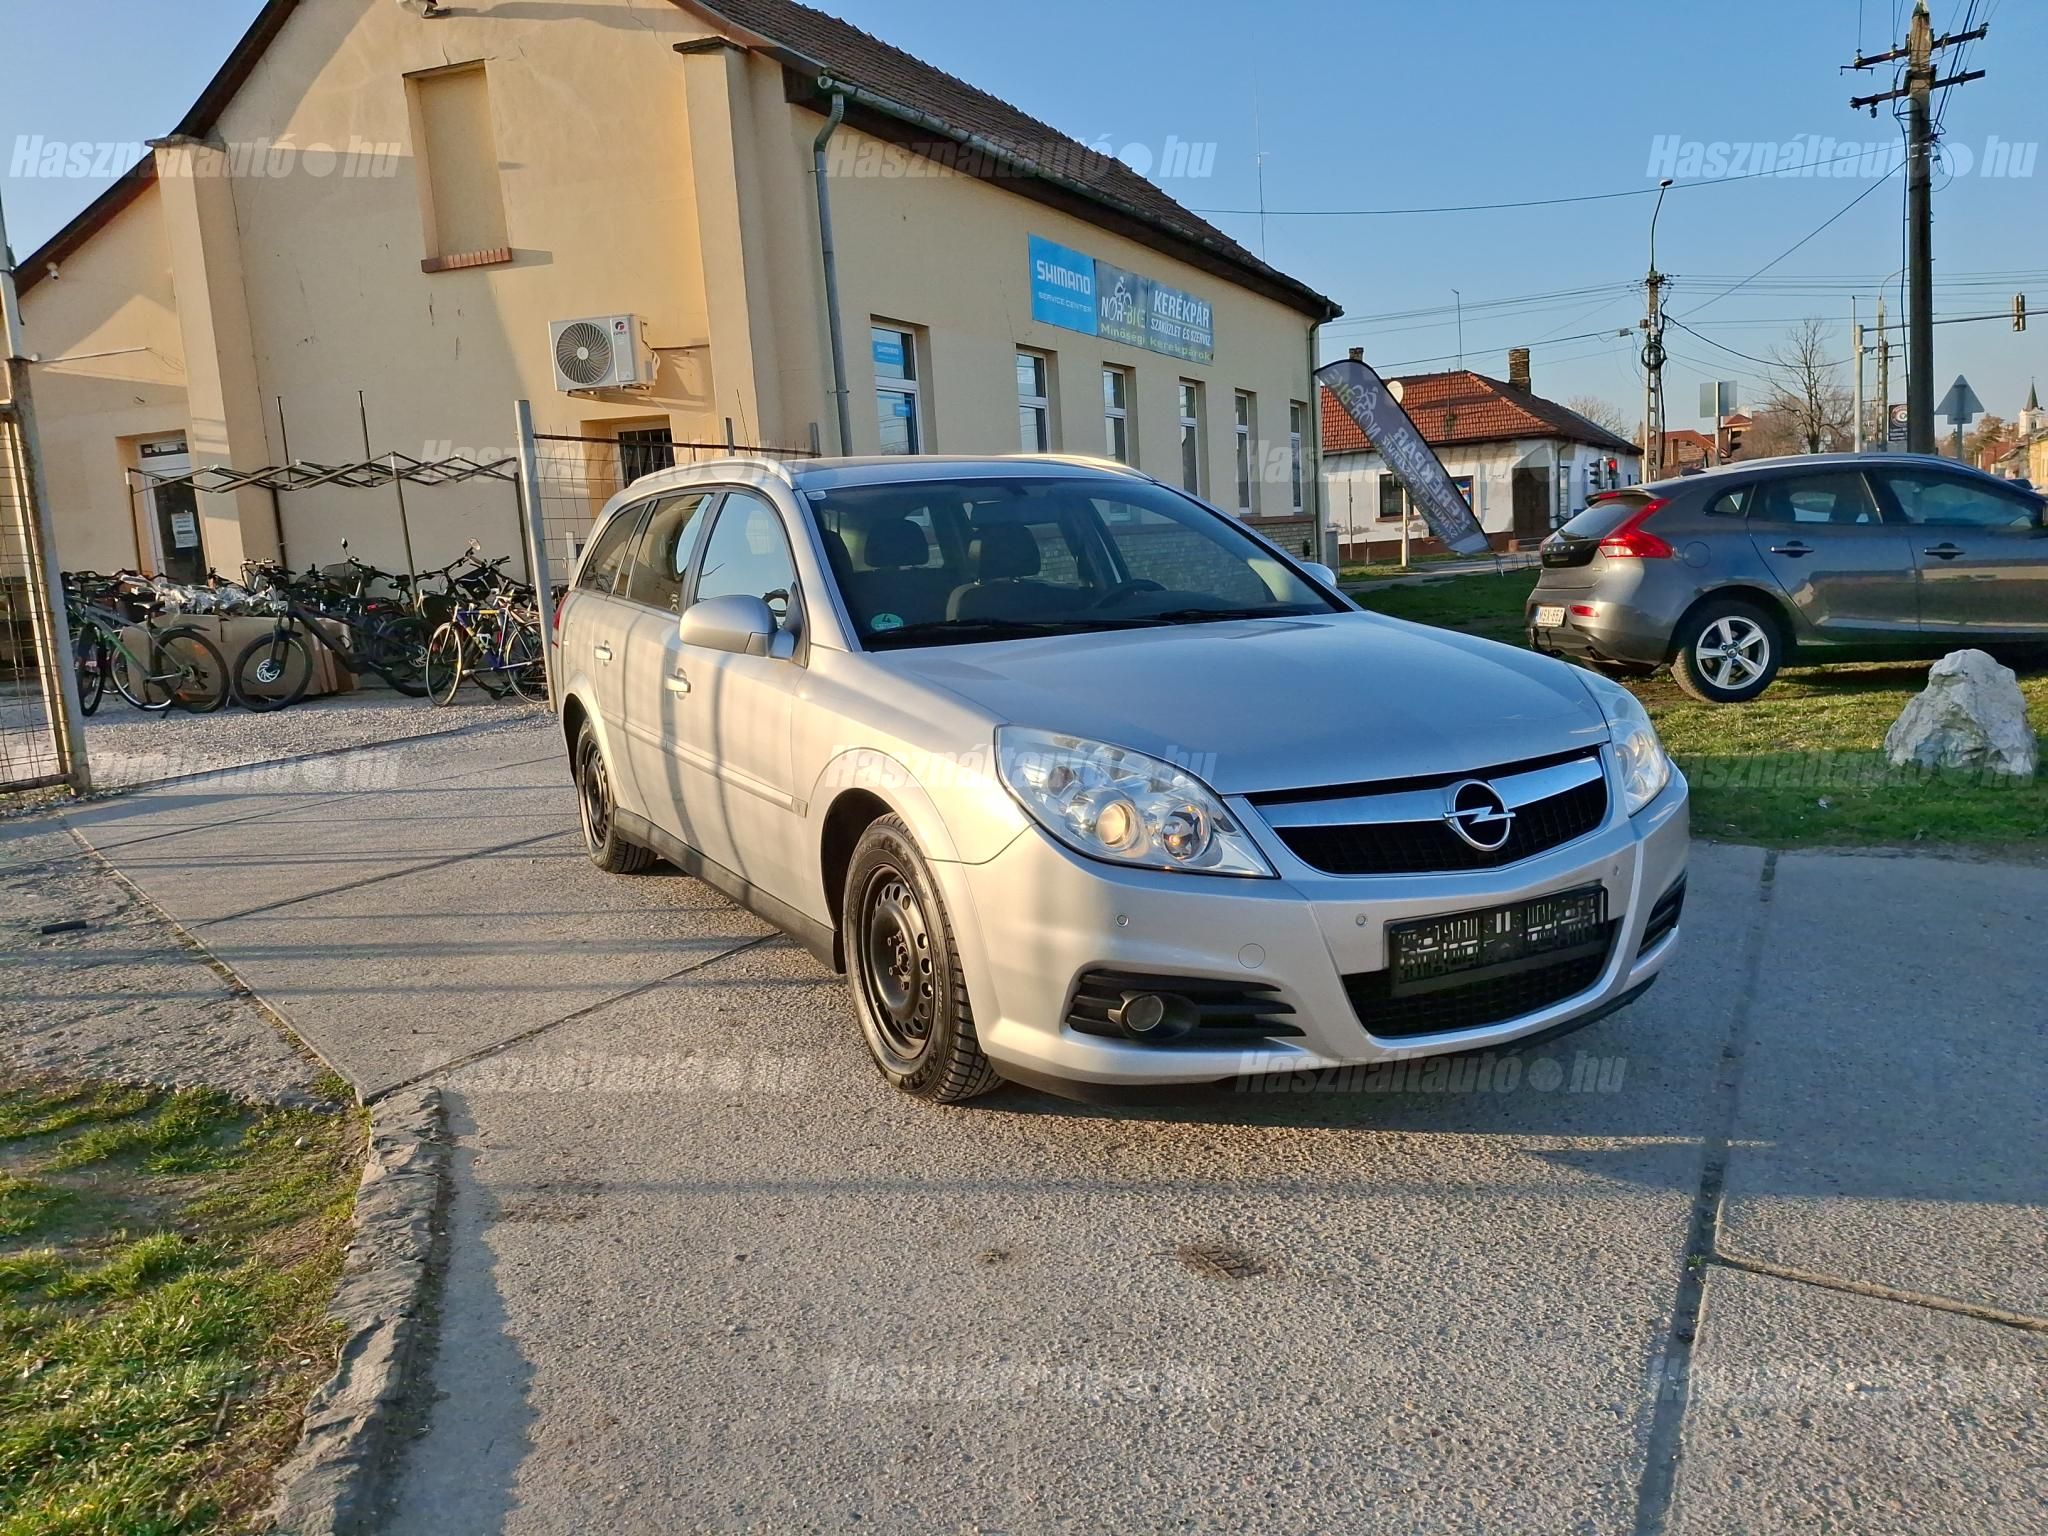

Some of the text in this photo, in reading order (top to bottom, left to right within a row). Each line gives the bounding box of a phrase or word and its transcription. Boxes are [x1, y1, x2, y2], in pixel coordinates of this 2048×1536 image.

[1036, 259, 1091, 296] SHIMANO
[1038, 291, 1092, 313] SERVICE CENTER
[1154, 290, 1210, 329] KERÉKPÁR
[1151, 318, 1212, 346] SZAKÜZLET ÉS SZERVIZ
[882, 614, 891, 623] 4
